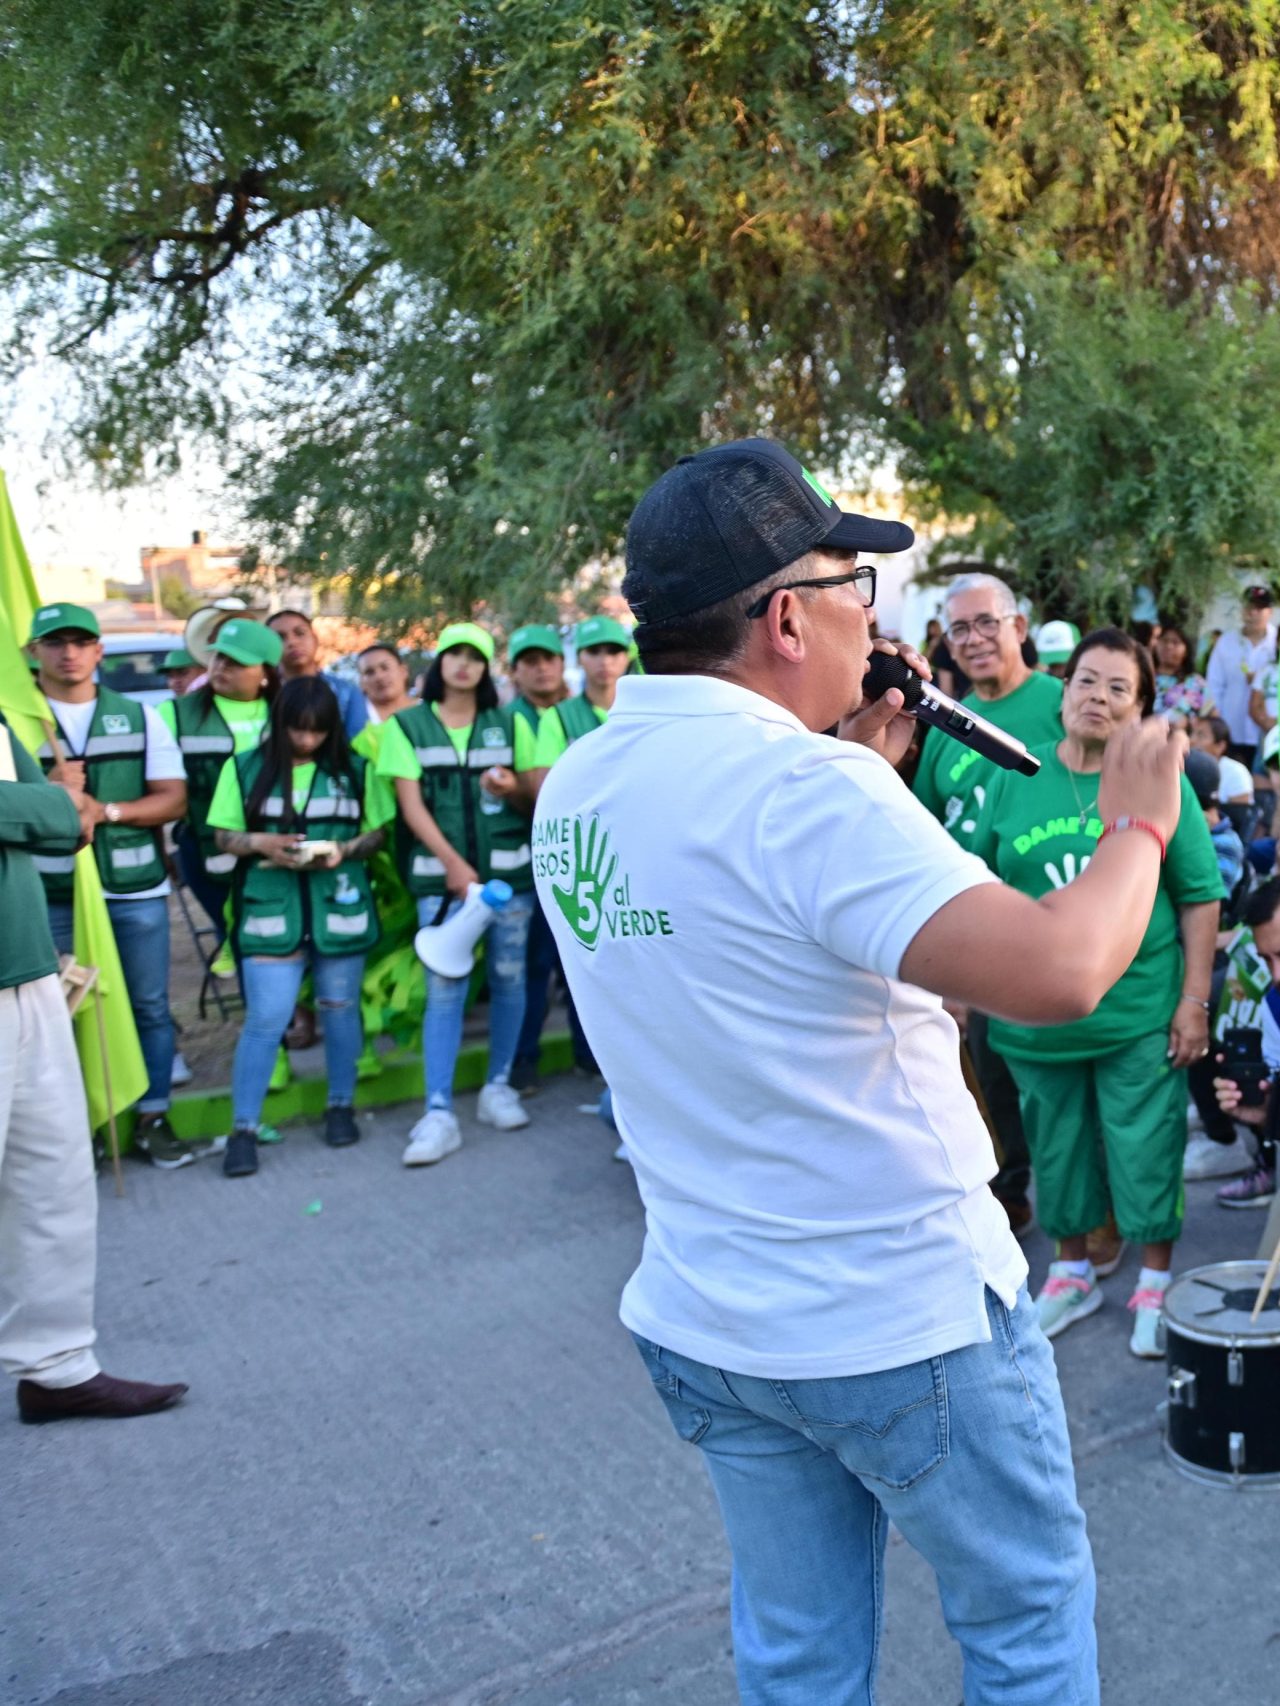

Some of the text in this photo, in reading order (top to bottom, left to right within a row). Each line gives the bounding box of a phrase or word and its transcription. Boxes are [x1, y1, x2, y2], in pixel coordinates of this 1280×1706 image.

[1013, 816, 1080, 856] DAME
[577, 873, 631, 932] 5 al
[605, 909, 674, 938] VERDE
